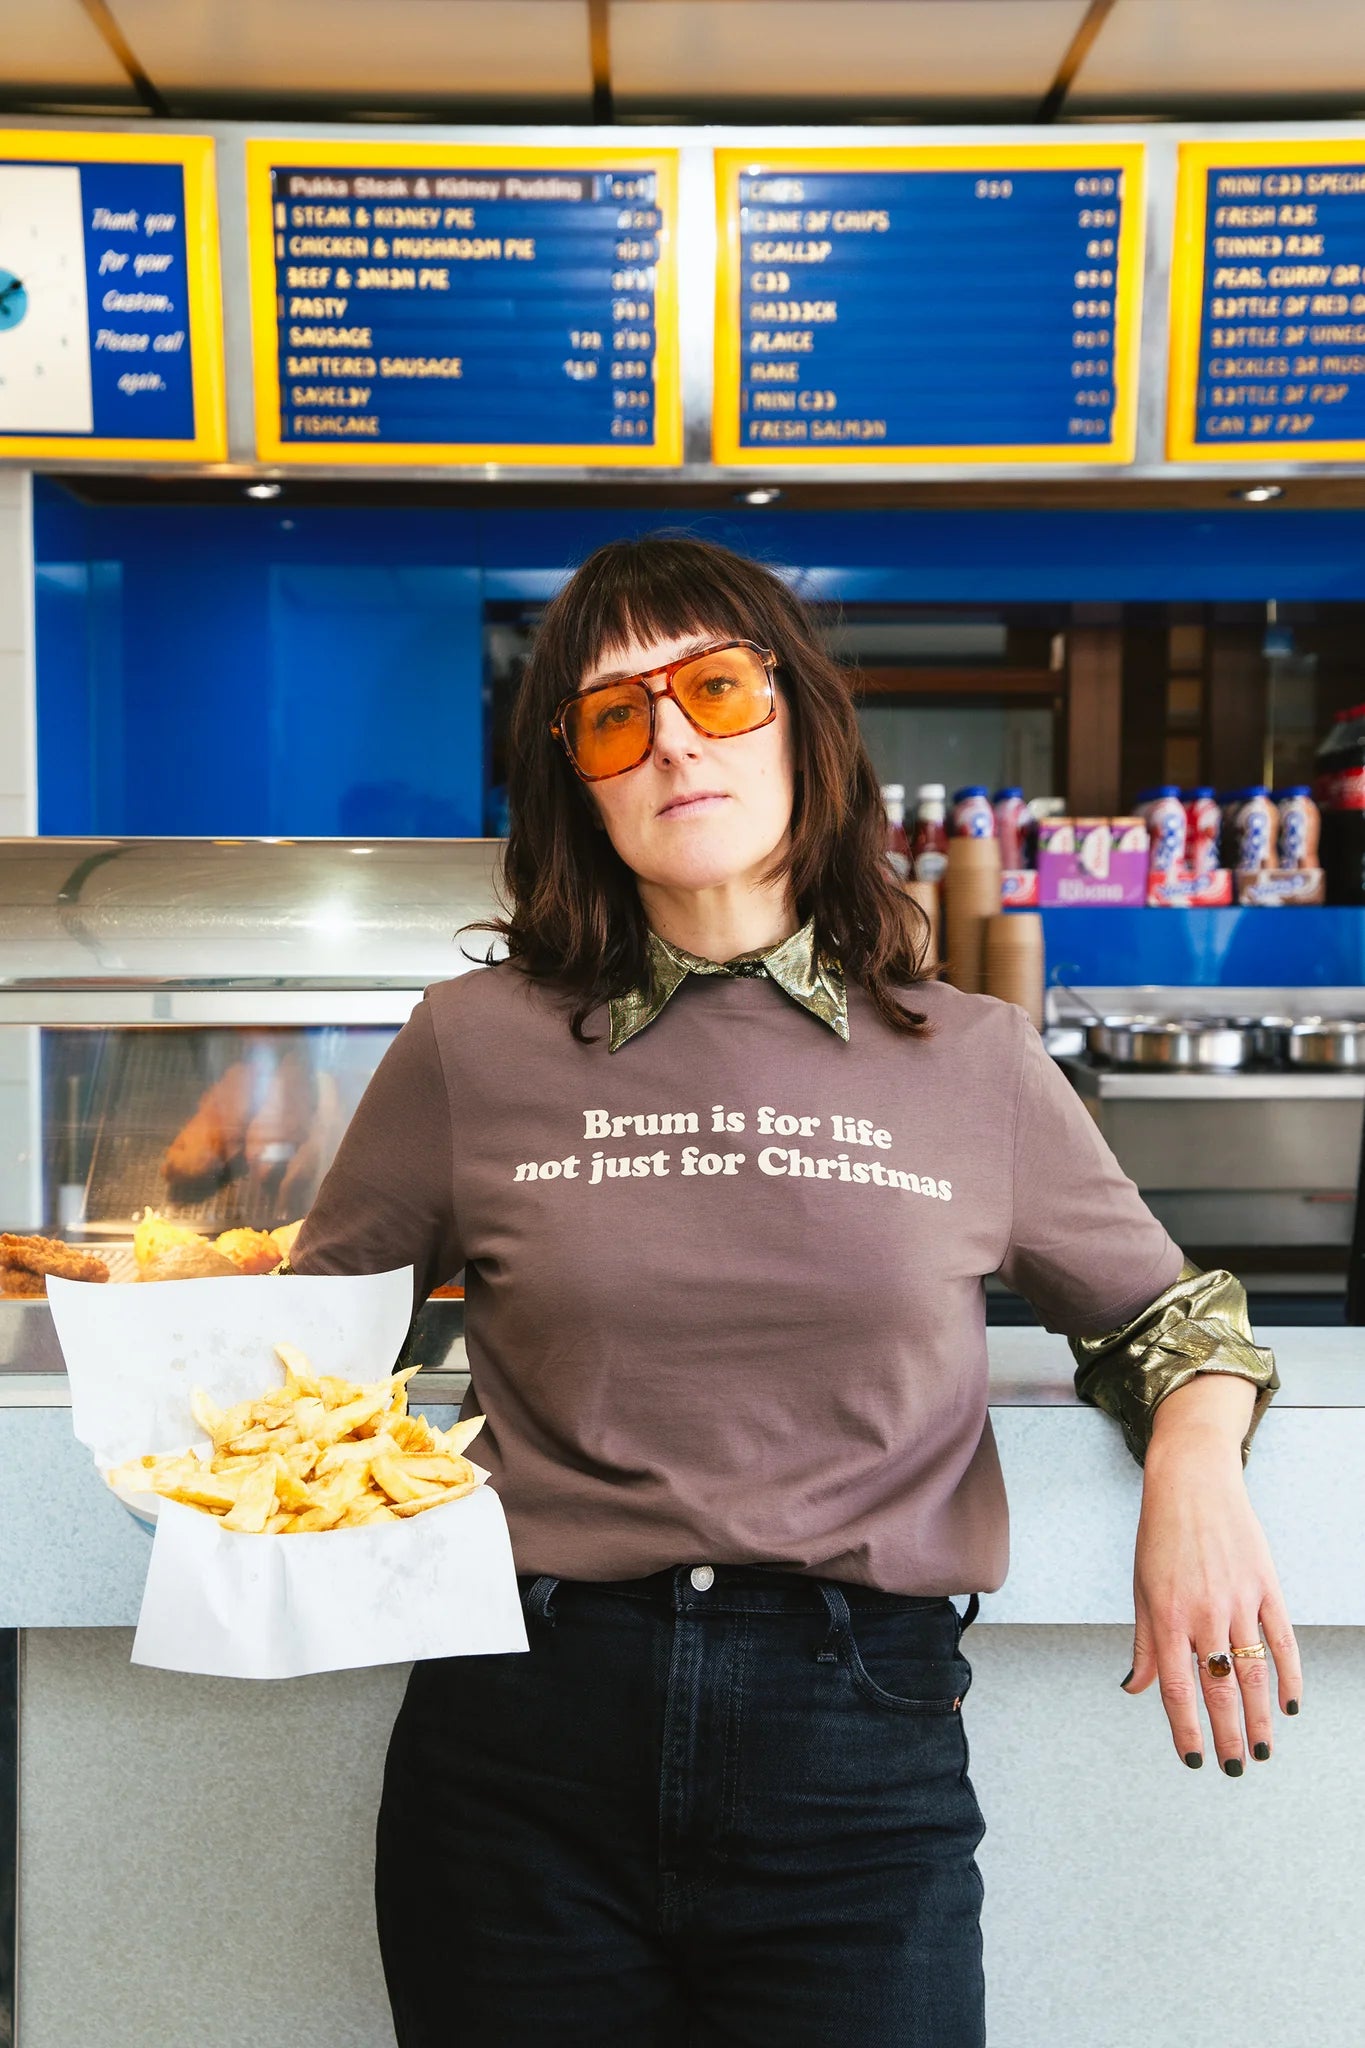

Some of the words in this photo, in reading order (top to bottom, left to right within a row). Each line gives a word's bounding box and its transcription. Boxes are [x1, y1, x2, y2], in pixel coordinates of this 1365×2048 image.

[289, 176, 350, 197] Pukka
[351, 176, 410, 198] Steak
[433, 176, 503, 200] Kidney
[503, 177, 584, 201] Pudding
[1216, 175, 1264, 196] MINI
[1261, 174, 1304, 196] COD
[91, 207, 139, 231] Thank
[143, 213, 177, 236] you
[291, 205, 351, 227] STEAK
[354, 206, 371, 228] &
[373, 207, 442, 229] KIDNEY
[443, 207, 475, 229] PIE
[803, 210, 832, 233] OF
[830, 210, 890, 233] CHIPS
[1215, 205, 1277, 228] FRESH
[289, 235, 369, 258] CHICKEN
[372, 237, 390, 259] &
[391, 237, 502, 260] MUSHROOM
[503, 238, 535, 260] PIE
[749, 241, 833, 264] SCALLOP
[1213, 235, 1285, 258] TINNED
[98, 249, 129, 275] for
[133, 253, 173, 277] your
[287, 266, 331, 289] BEEF
[335, 267, 352, 289] &
[355, 267, 417, 290] ONION
[418, 268, 450, 290] PIE
[750, 271, 790, 293] COD
[1267, 265, 1333, 288] CURRY
[1331, 264, 1362, 287] OR
[289, 296, 348, 319] PASTY
[749, 301, 837, 323] HADDOCK
[1211, 295, 1281, 319] BOTTLE
[1282, 295, 1311, 317] OF
[1310, 294, 1351, 316] RED
[95, 328, 150, 352] Please
[152, 331, 185, 353] call
[289, 326, 372, 348] SAUSAGE
[749, 331, 813, 353] PLAICE
[1211, 326, 1279, 349] BOTTLE
[1282, 325, 1309, 347] OF
[287, 356, 378, 377] BATTERED
[379, 357, 462, 378] SAUSAGE
[750, 362, 798, 382] HAKE
[1209, 356, 1291, 379] COCKLES
[1292, 356, 1320, 376] OR
[753, 391, 796, 410] MINI
[797, 390, 837, 412] COD
[1211, 385, 1278, 407] BOTTLE
[1282, 384, 1307, 405] OF
[1309, 383, 1349, 404] POP
[293, 415, 379, 436] FISHCAKE
[749, 420, 808, 441] FRESH
[810, 419, 887, 440] SALMON
[1206, 416, 1245, 436] CAN
[1249, 414, 1273, 435] OF
[1275, 413, 1315, 434] POP
[582, 1109, 700, 1140] Brum
[711, 1104, 746, 1133] is
[756, 1105, 821, 1137] for
[830, 1114, 893, 1150] life
[512, 1155, 581, 1182] not
[587, 1149, 671, 1185] just
[680, 1146, 746, 1176] for
[758, 1146, 953, 1201] Christmas
